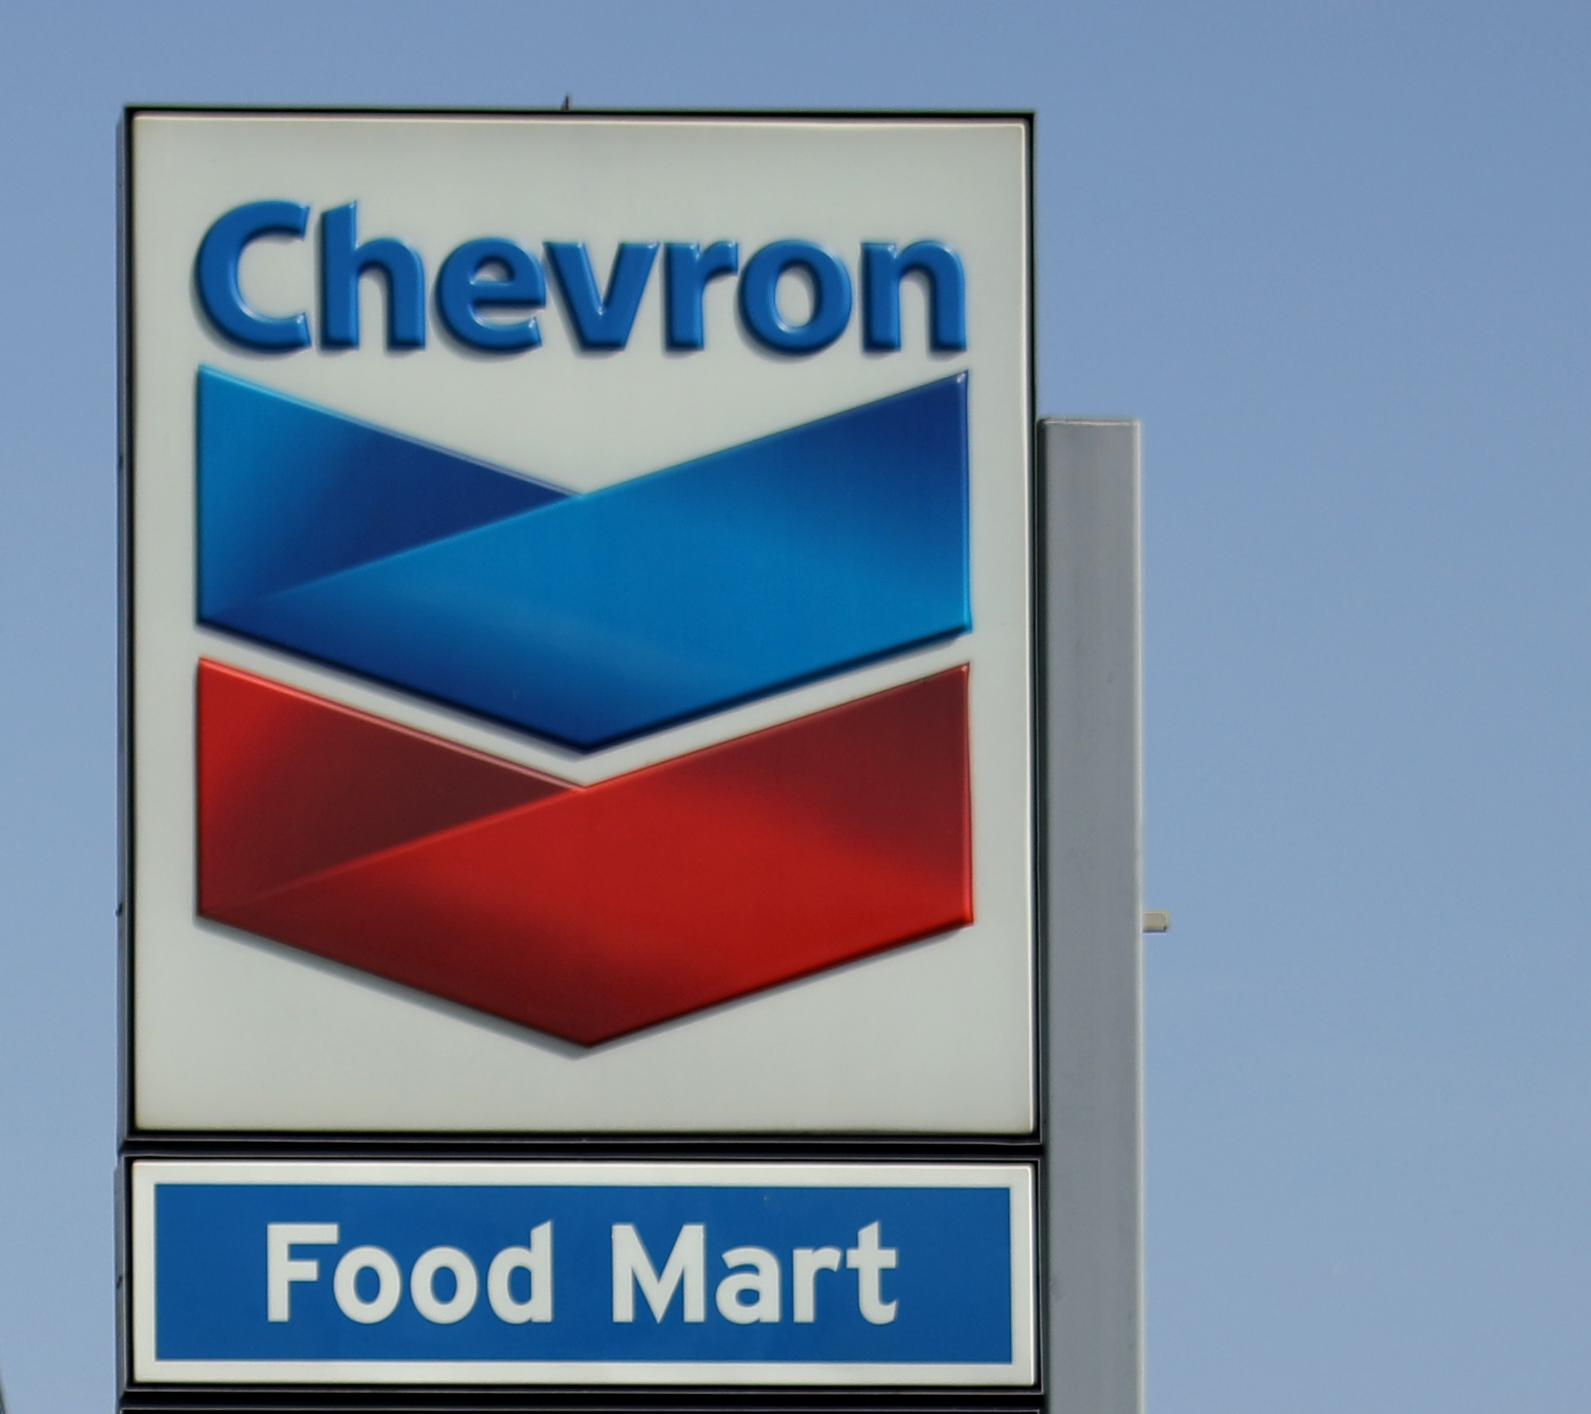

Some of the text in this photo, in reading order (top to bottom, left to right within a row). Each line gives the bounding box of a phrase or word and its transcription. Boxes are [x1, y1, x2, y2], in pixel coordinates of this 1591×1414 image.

[194, 199, 968, 355] Chevron
[265, 1218, 899, 1327] Food Mart
